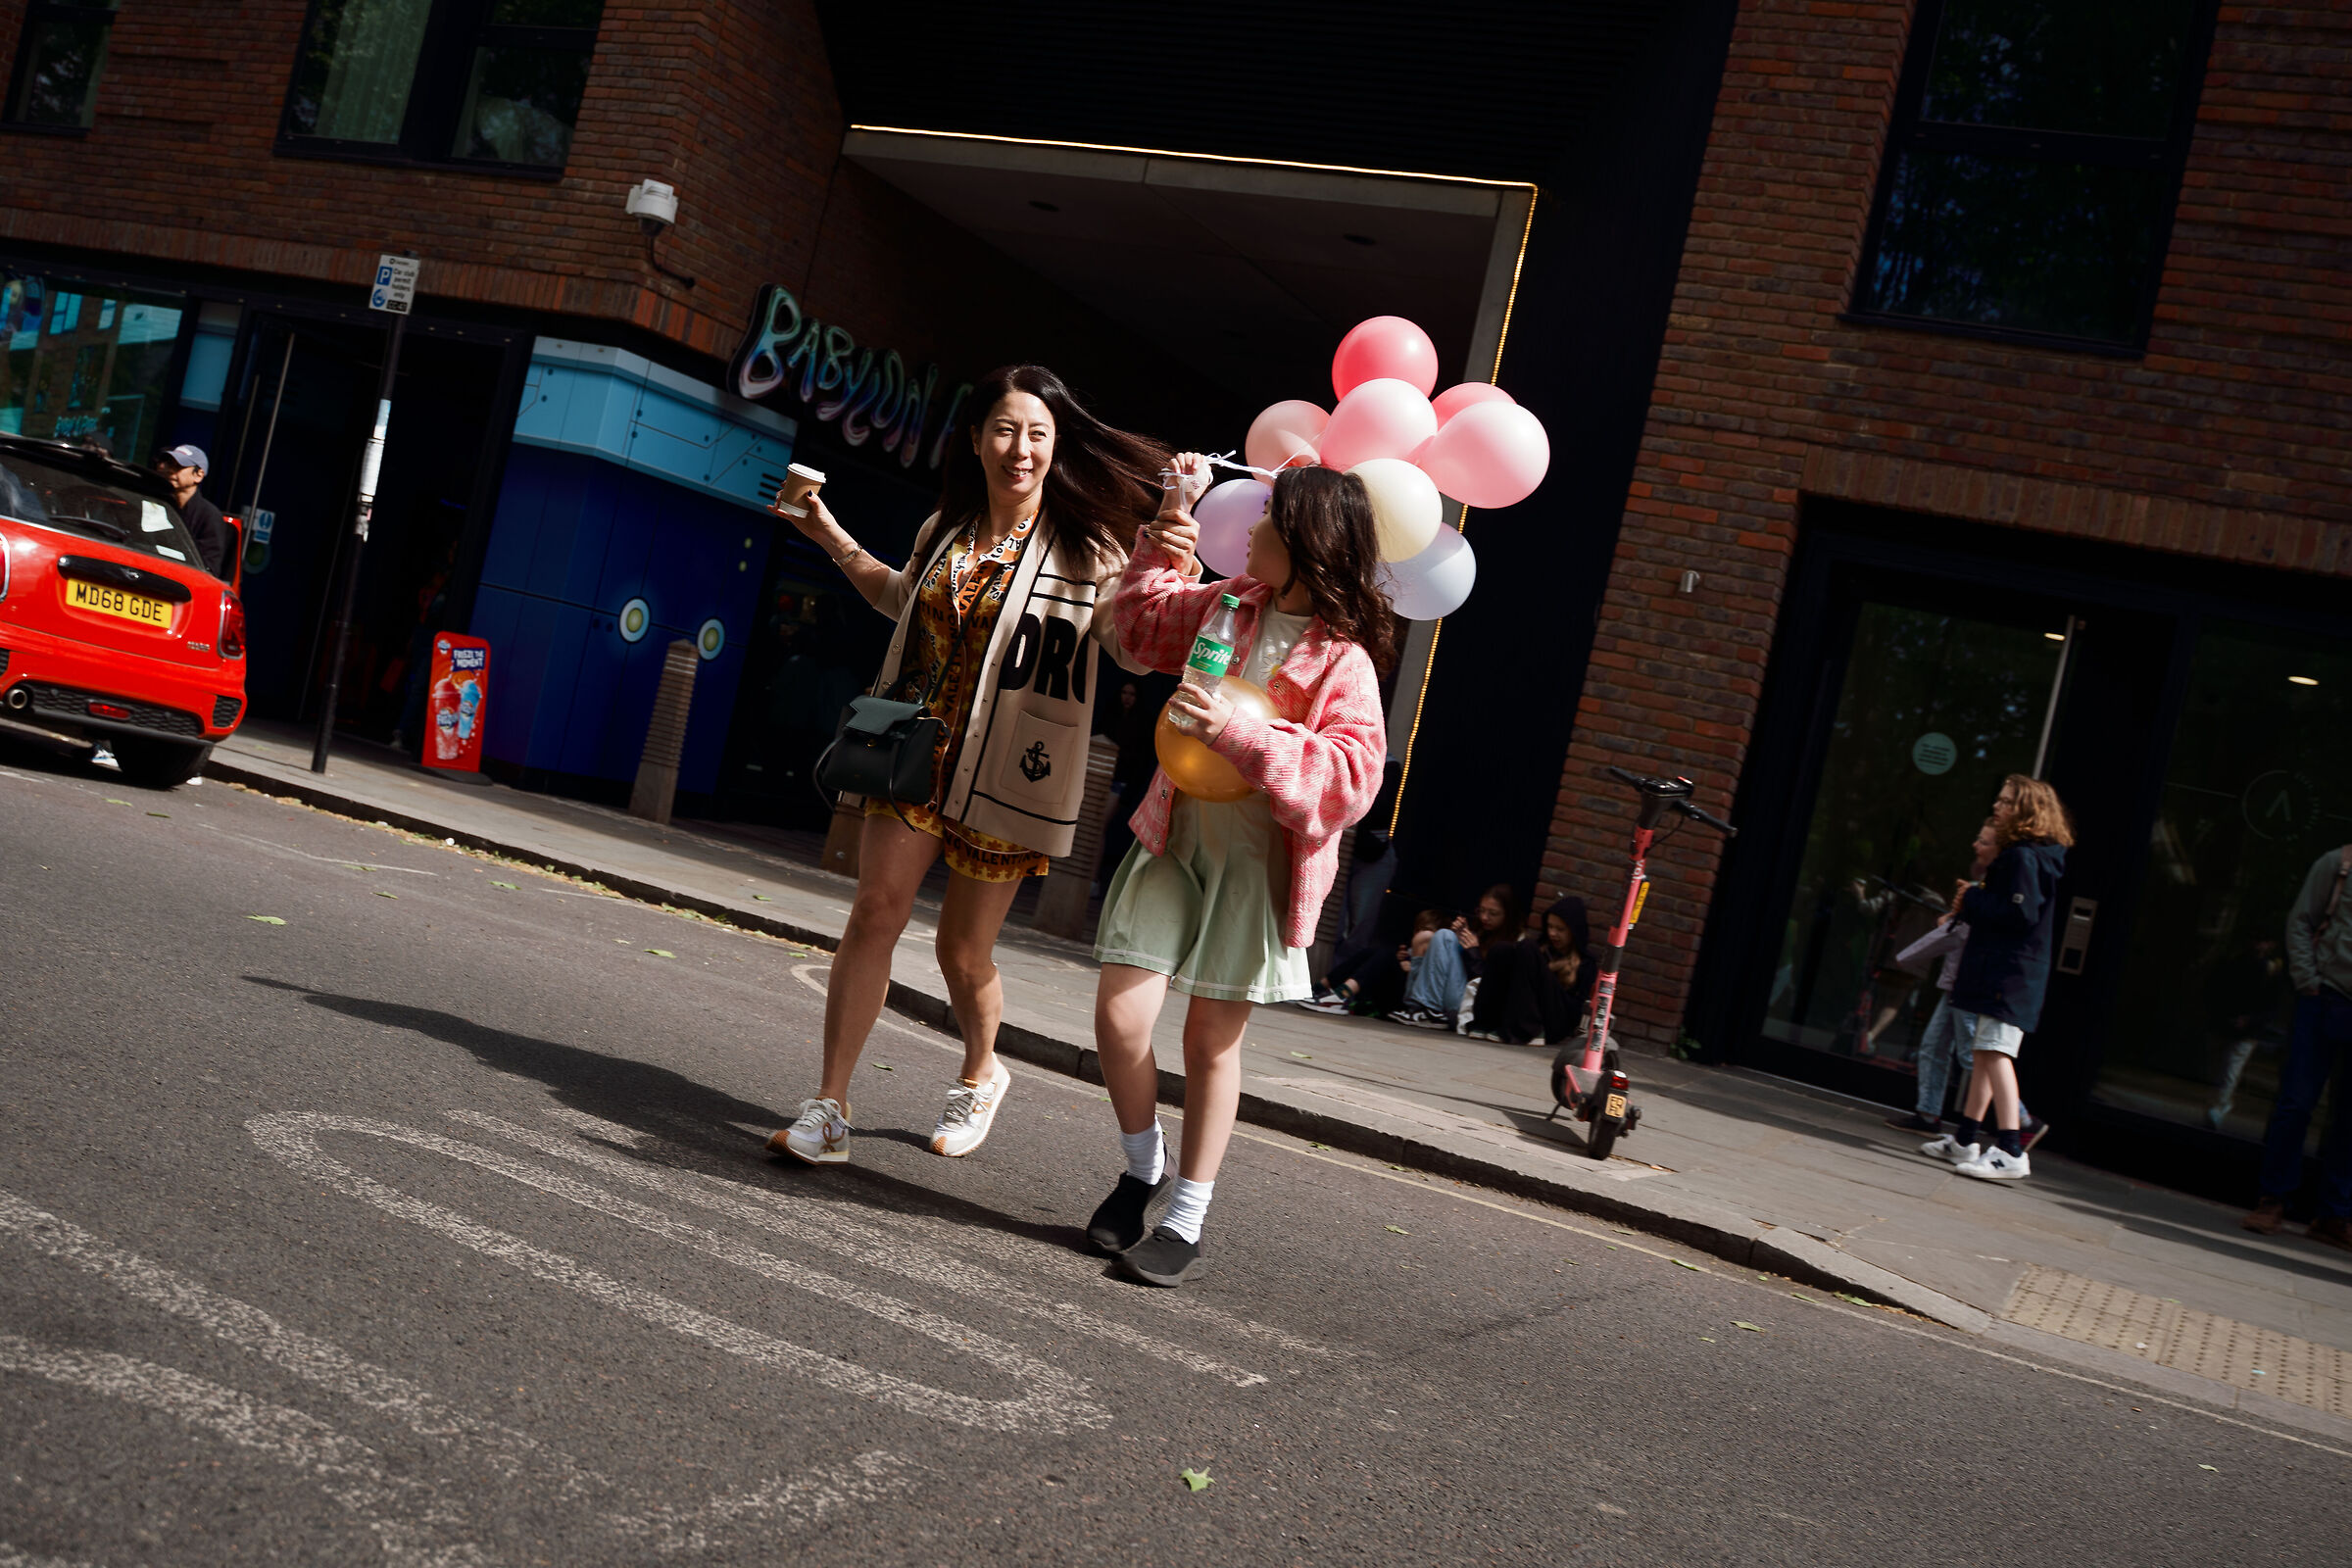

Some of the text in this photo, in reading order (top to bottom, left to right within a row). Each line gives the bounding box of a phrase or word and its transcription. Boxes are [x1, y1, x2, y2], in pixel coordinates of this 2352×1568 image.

[379, 269, 390, 284] P
[738, 284, 940, 470] BABYLON
[75, 583, 164, 621] MD68 GDE
[1194, 642, 1231, 665] Sprite
